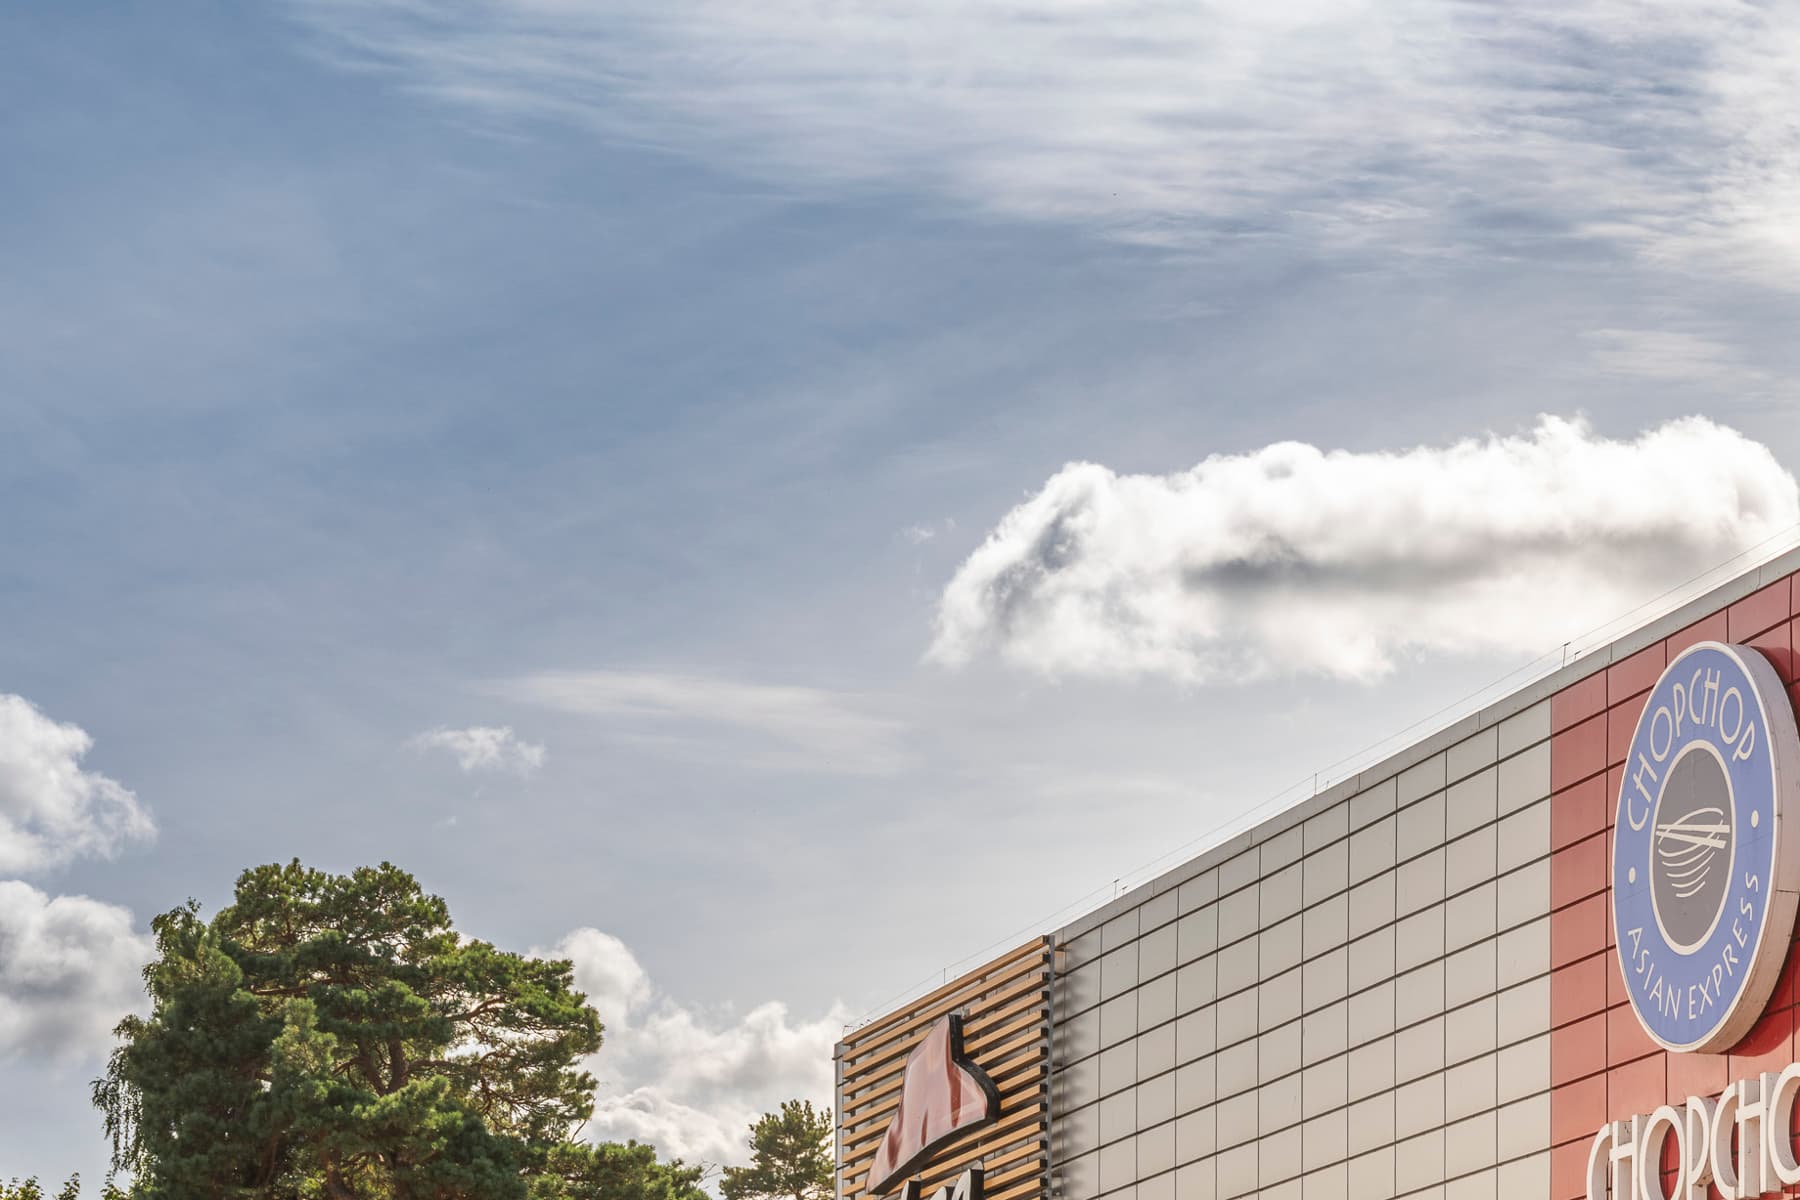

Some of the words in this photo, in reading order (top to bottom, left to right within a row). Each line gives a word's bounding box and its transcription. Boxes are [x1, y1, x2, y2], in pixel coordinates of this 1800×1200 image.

[1627, 668, 1757, 832] CHOPCHOP
[1627, 925, 1681, 1021] ASIAN
[1687, 870, 1759, 1021] EXPRESS
